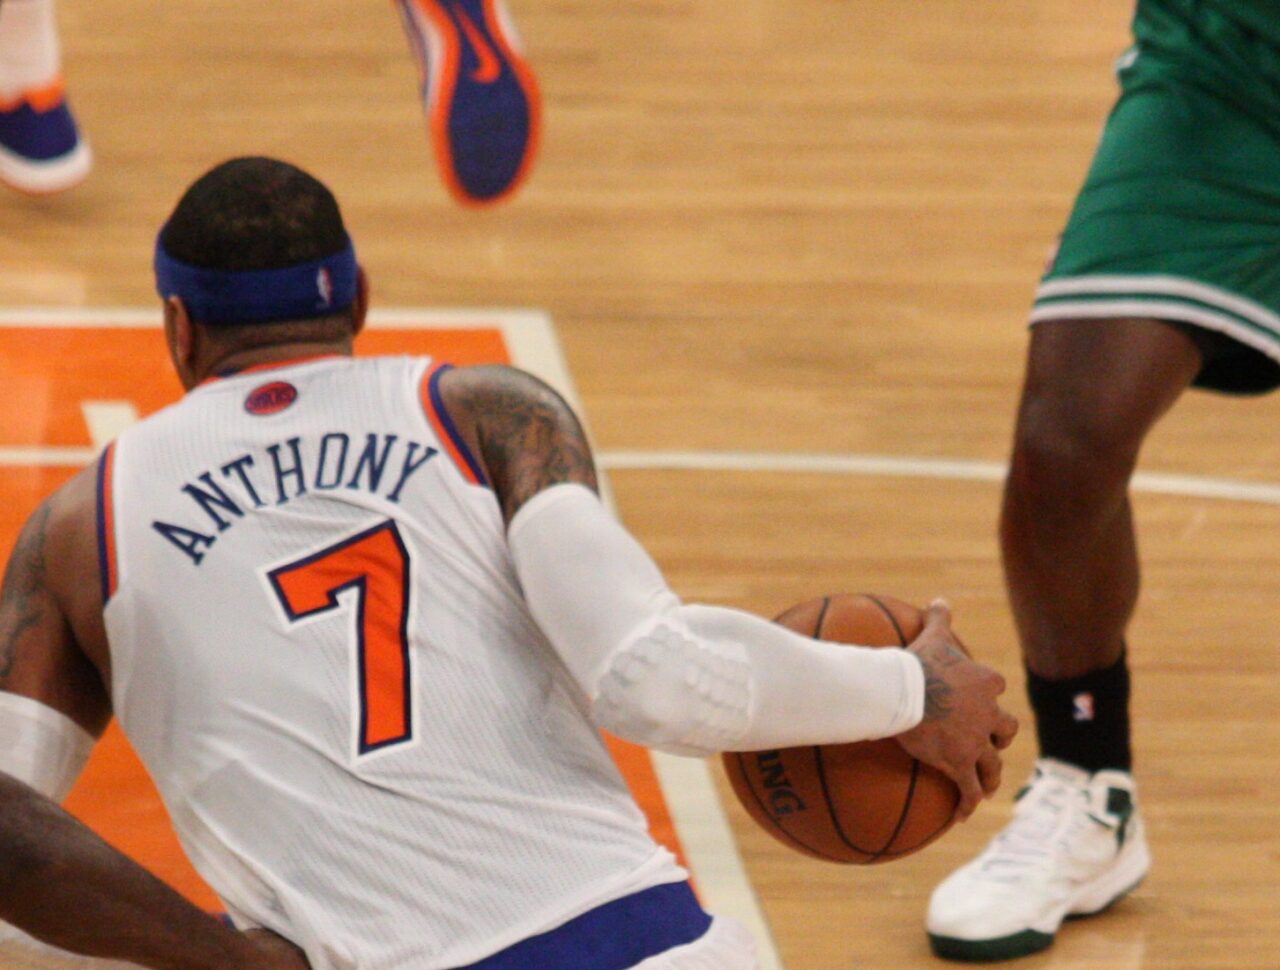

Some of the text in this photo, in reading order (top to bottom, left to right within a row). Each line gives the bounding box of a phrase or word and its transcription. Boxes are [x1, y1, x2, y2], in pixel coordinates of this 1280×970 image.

[151, 432, 438, 566] ANTHONY
[264, 516, 415, 758] 7
[755, 749, 807, 816] ING
